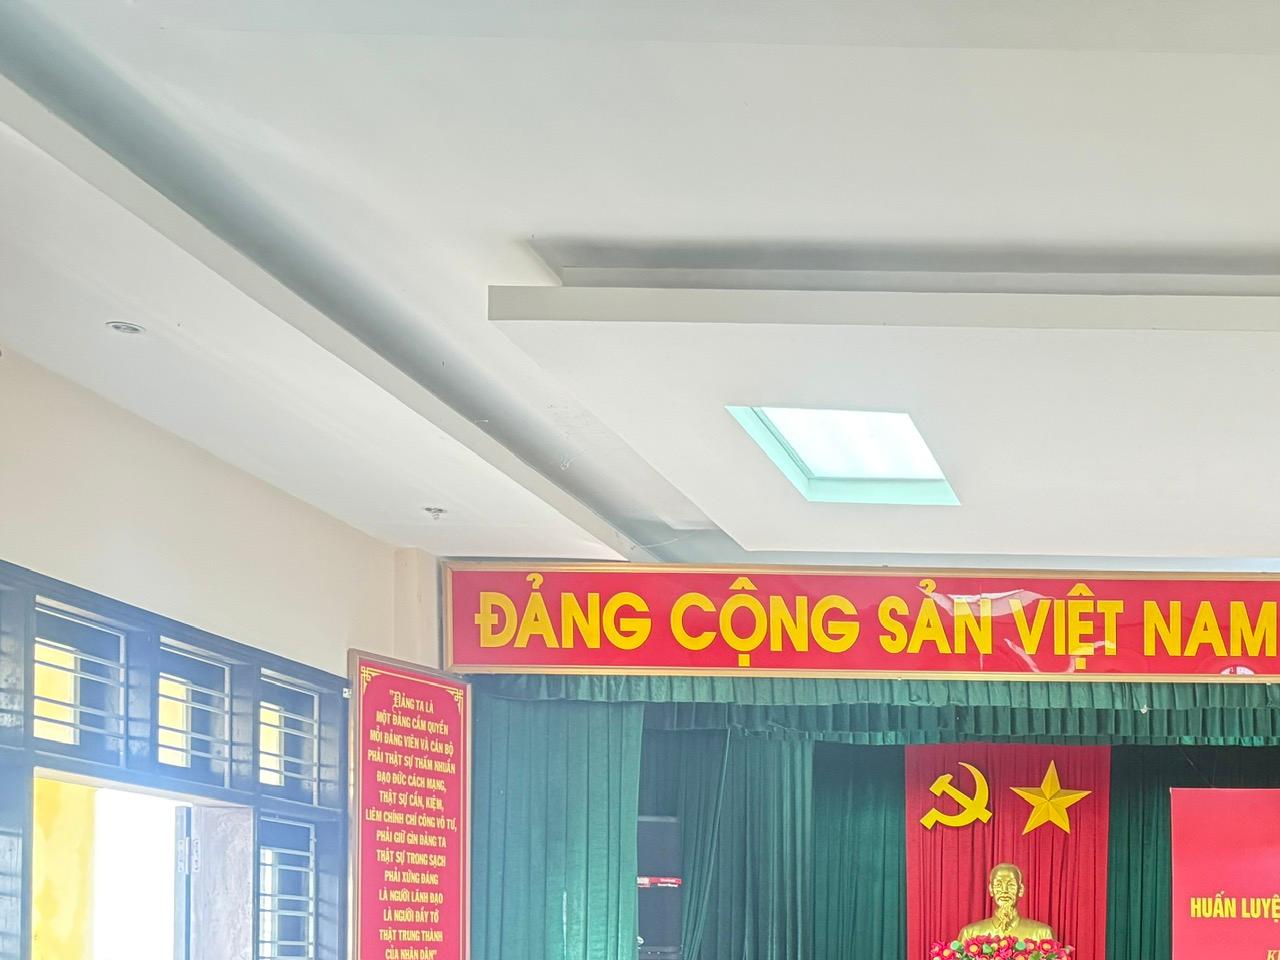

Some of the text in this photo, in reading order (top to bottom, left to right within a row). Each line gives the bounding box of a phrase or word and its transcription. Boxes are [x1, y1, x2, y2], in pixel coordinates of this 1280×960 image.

[473, 572, 647, 653] ĐẢNG
[669, 575, 861, 668] CỘNG
[877, 578, 993, 655] SẢN
[1008, 582, 1124, 670] VIỆT
[1144, 599, 1278, 657] NAM
[416, 700, 424, 712] TA
[426, 700, 433, 714] LÀ
[376, 709, 391, 725] MỘT
[392, 711, 410, 728] ĐẢNG
[384, 729, 403, 746] ĐẢNG
[404, 734, 419, 749] VIÊN
[421, 737, 429, 751] VÀ
[430, 738, 443, 753] CÁN
[444, 741, 454, 757] BỘ
[368, 747, 383, 762] PHẢI
[385, 751, 403, 767] THẬT
[404, 755, 414, 769] SỰ
[377, 770, 391, 784] ĐẠO
[408, 773, 425, 788] CÁCH
[380, 788, 397, 806] THẬT
[399, 792, 408, 808] SỰ
[366, 806, 382, 821] LIÊM
[383, 809, 404, 824] CHÍNH
[405, 812, 417, 826] CHÍ
[418, 813, 435, 828] CÔNG
[436, 815, 445, 829] VÔ
[376, 826, 392, 842] PHẢI
[420, 831, 437, 846] ĐẢNG
[438, 836, 446, 848] TA
[377, 847, 446, 868] THẬT SỰ TRONG SẠCH
[384, 866, 401, 882] PHẢI
[421, 871, 439, 885] ĐÁNG
[379, 887, 387, 901] LÀ
[411, 889, 428, 903] LÃNH
[430, 892, 443, 905] ĐẠO
[1190, 891, 1236, 918] HUẤN
[384, 906, 392, 921] LÀ
[379, 927, 443, 943] THẬT TRUNG THÀNH
[385, 944, 399, 960] CỦA
[400, 946, 419, 960] NHÂN
